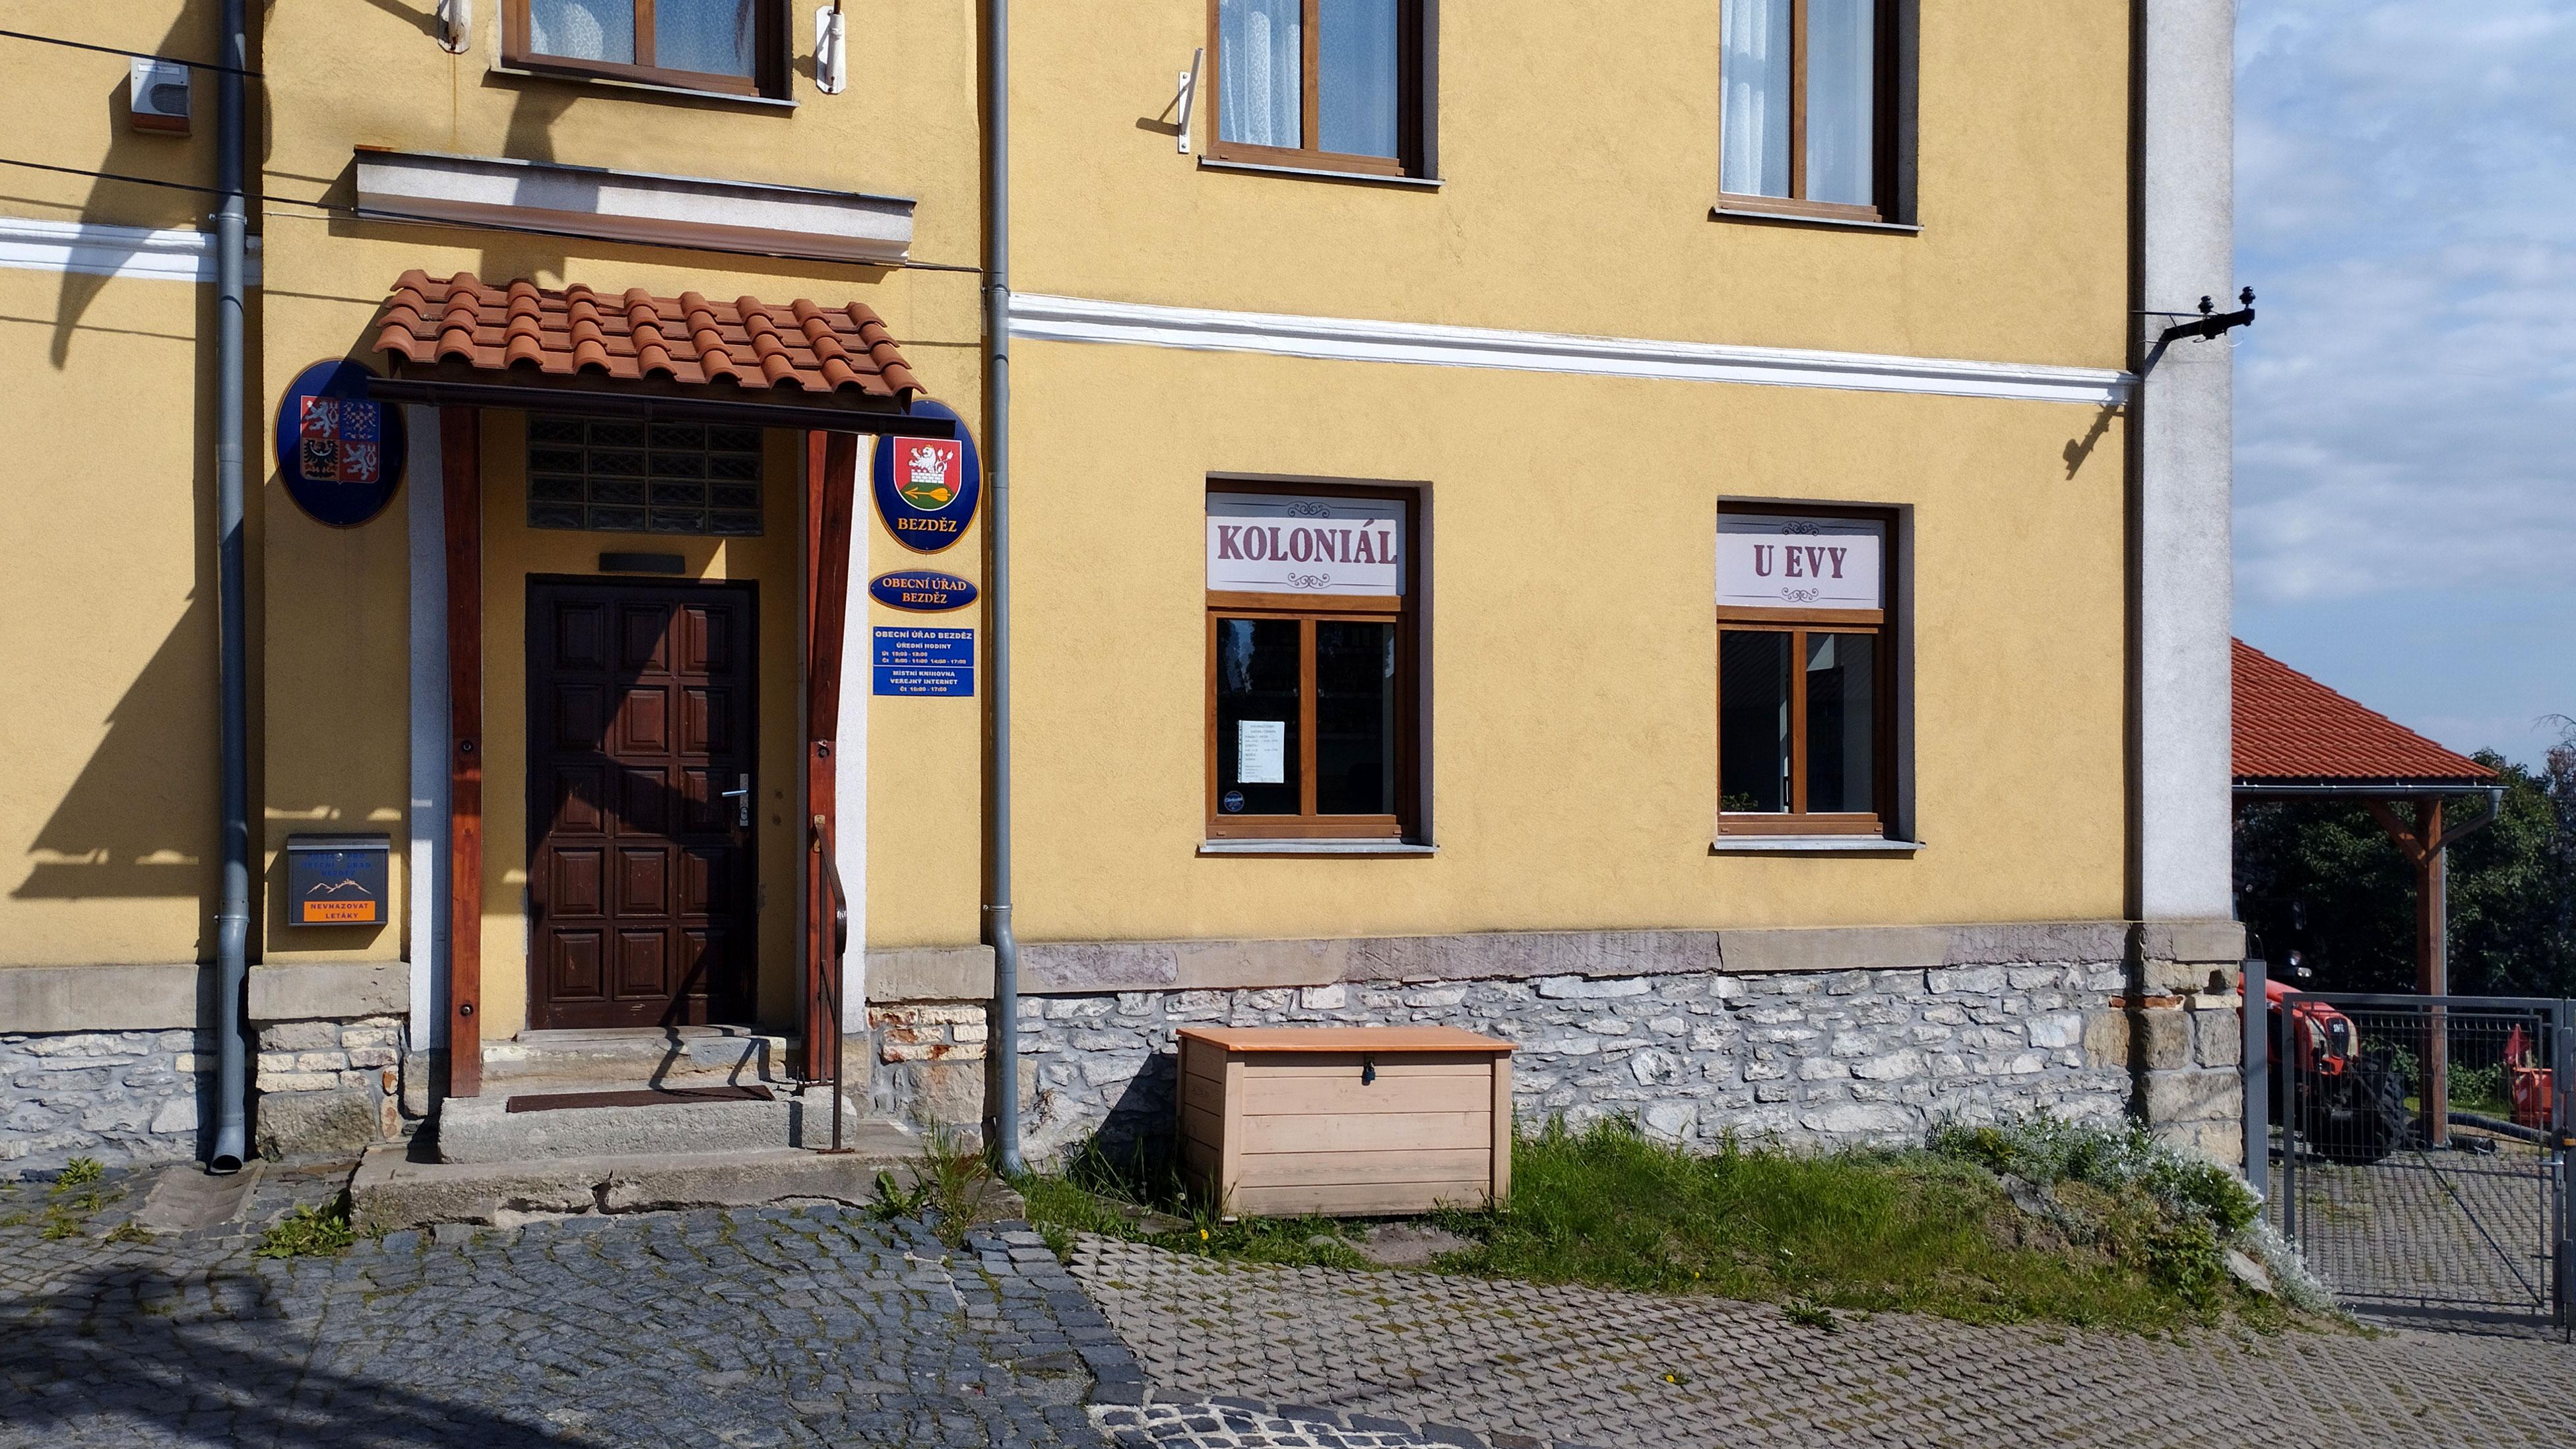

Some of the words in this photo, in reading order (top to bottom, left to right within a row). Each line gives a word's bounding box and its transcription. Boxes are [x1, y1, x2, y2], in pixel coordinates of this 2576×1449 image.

[897, 517, 957, 532] BEZDĚZ
[1217, 518, 1398, 565] KOLONIÁL
[1754, 545, 1774, 577] U
[1785, 546, 1848, 579] EVY
[882, 577, 930, 589] OBECNÍ
[932, 578, 967, 591] ÚŘAD
[903, 592, 948, 604] BEZDĚZ
[912, 630, 936, 639] ÚŘAD
